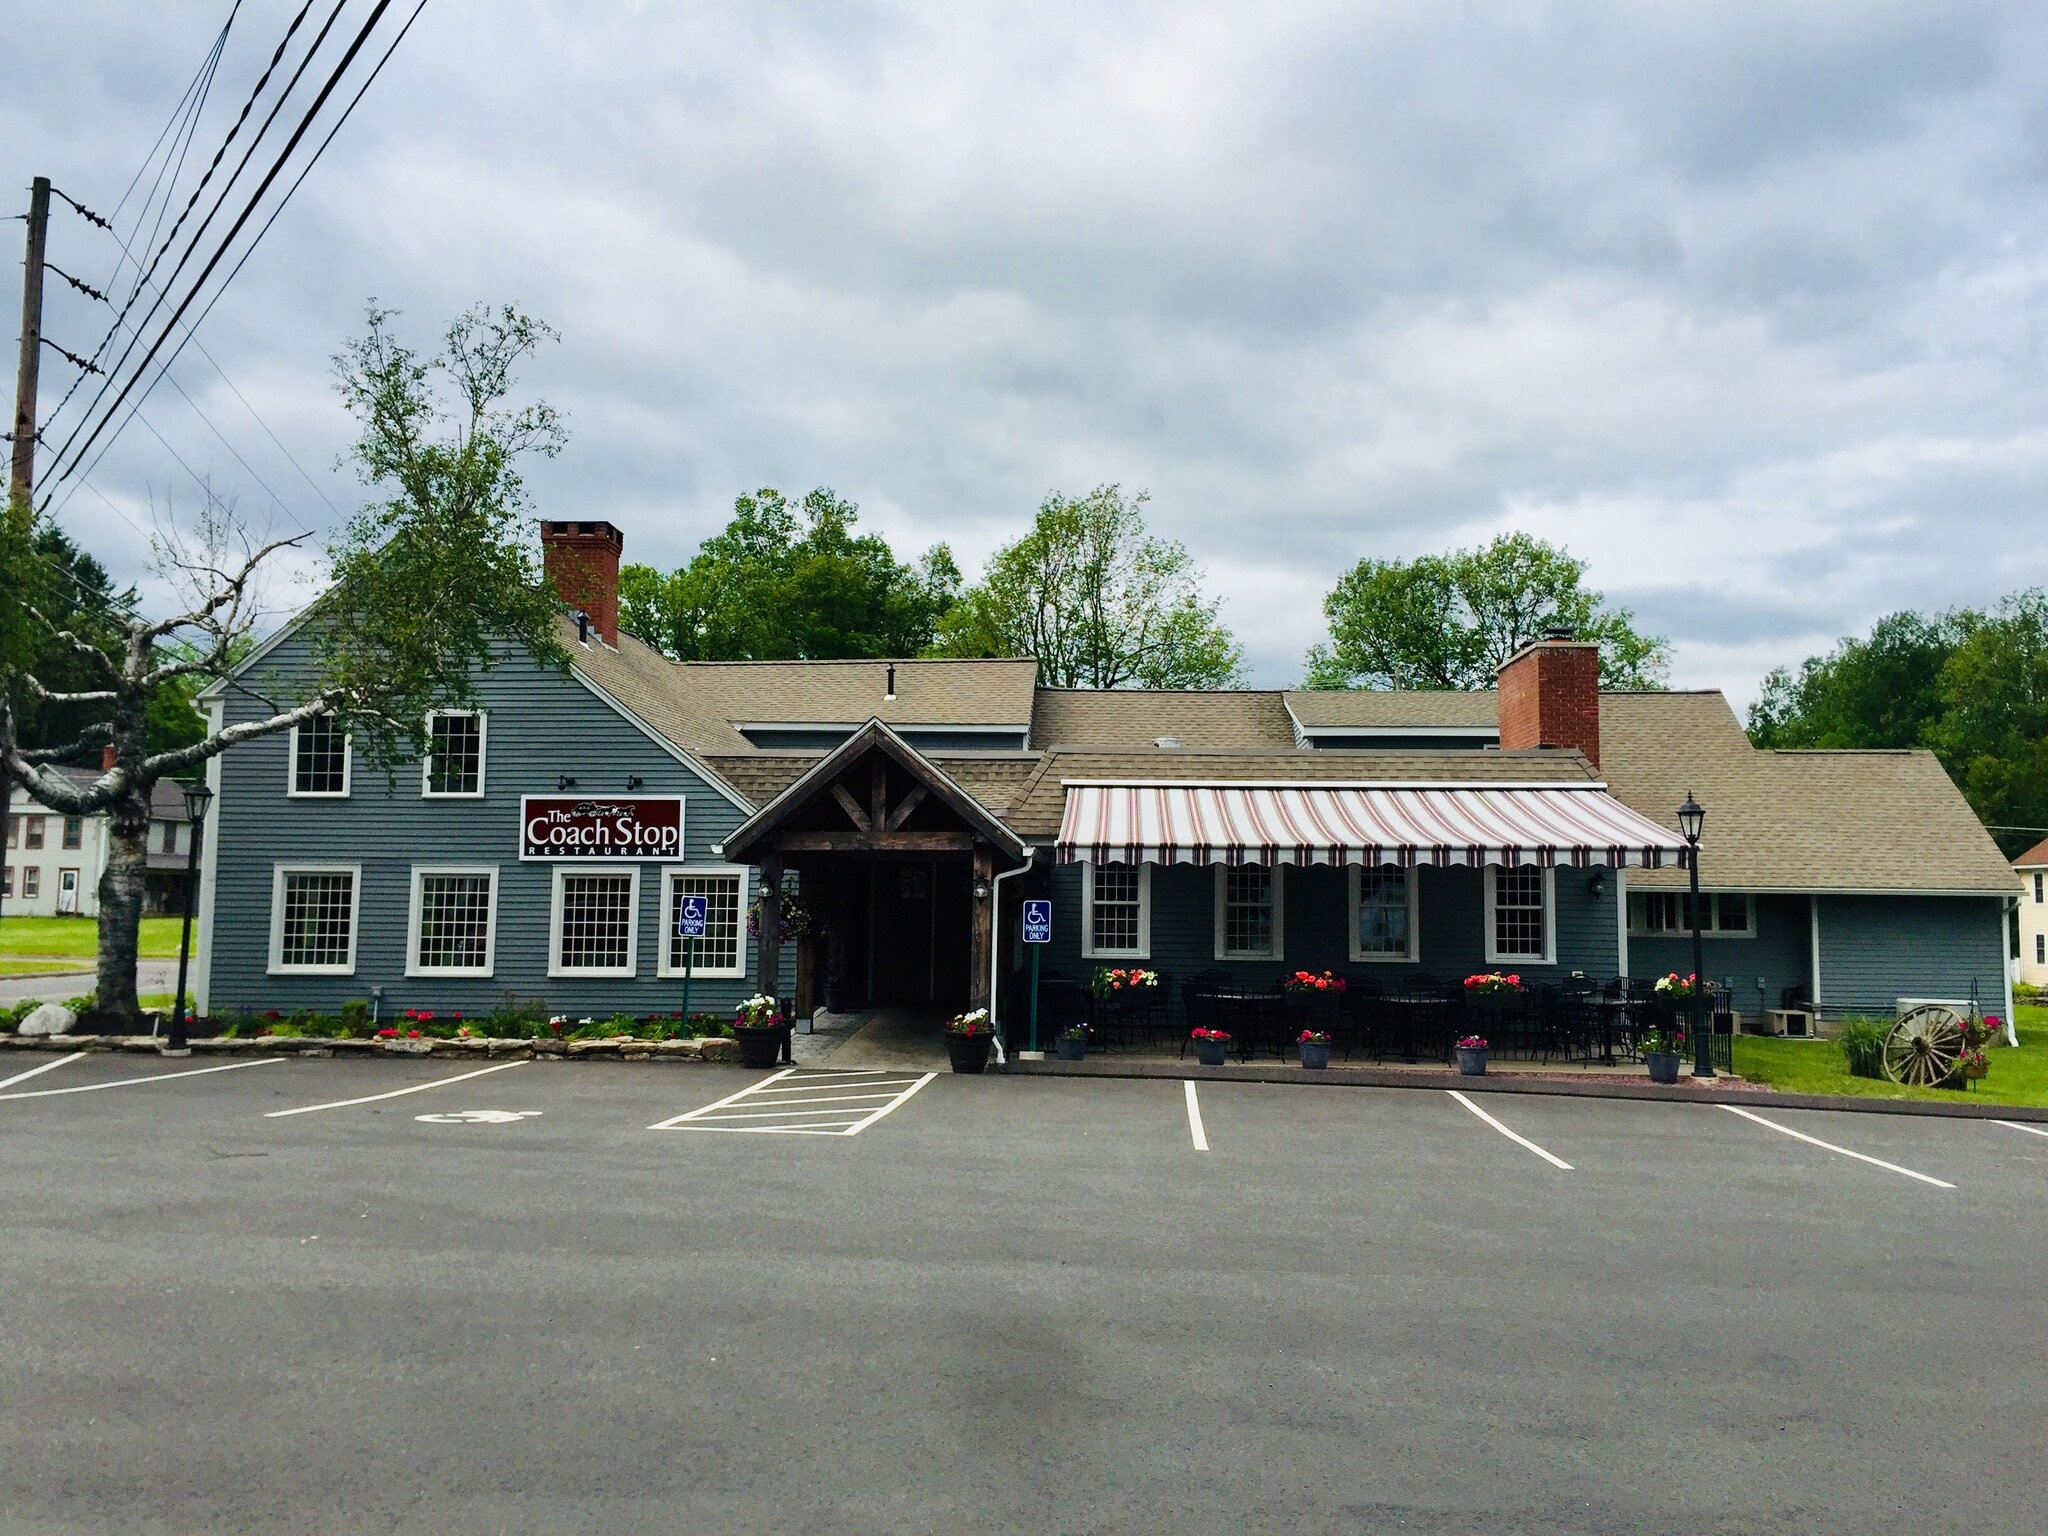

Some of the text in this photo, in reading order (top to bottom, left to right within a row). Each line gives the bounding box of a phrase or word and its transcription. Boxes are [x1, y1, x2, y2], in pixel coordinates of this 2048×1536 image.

[547, 809, 572, 823] The
[527, 817, 678, 851] Coach Stop
[528, 847, 675, 855] RESTAURANT
[681, 918, 703, 927] PARKING
[684, 926, 700, 934] ONLY
[1025, 924, 1048, 932] PARKING
